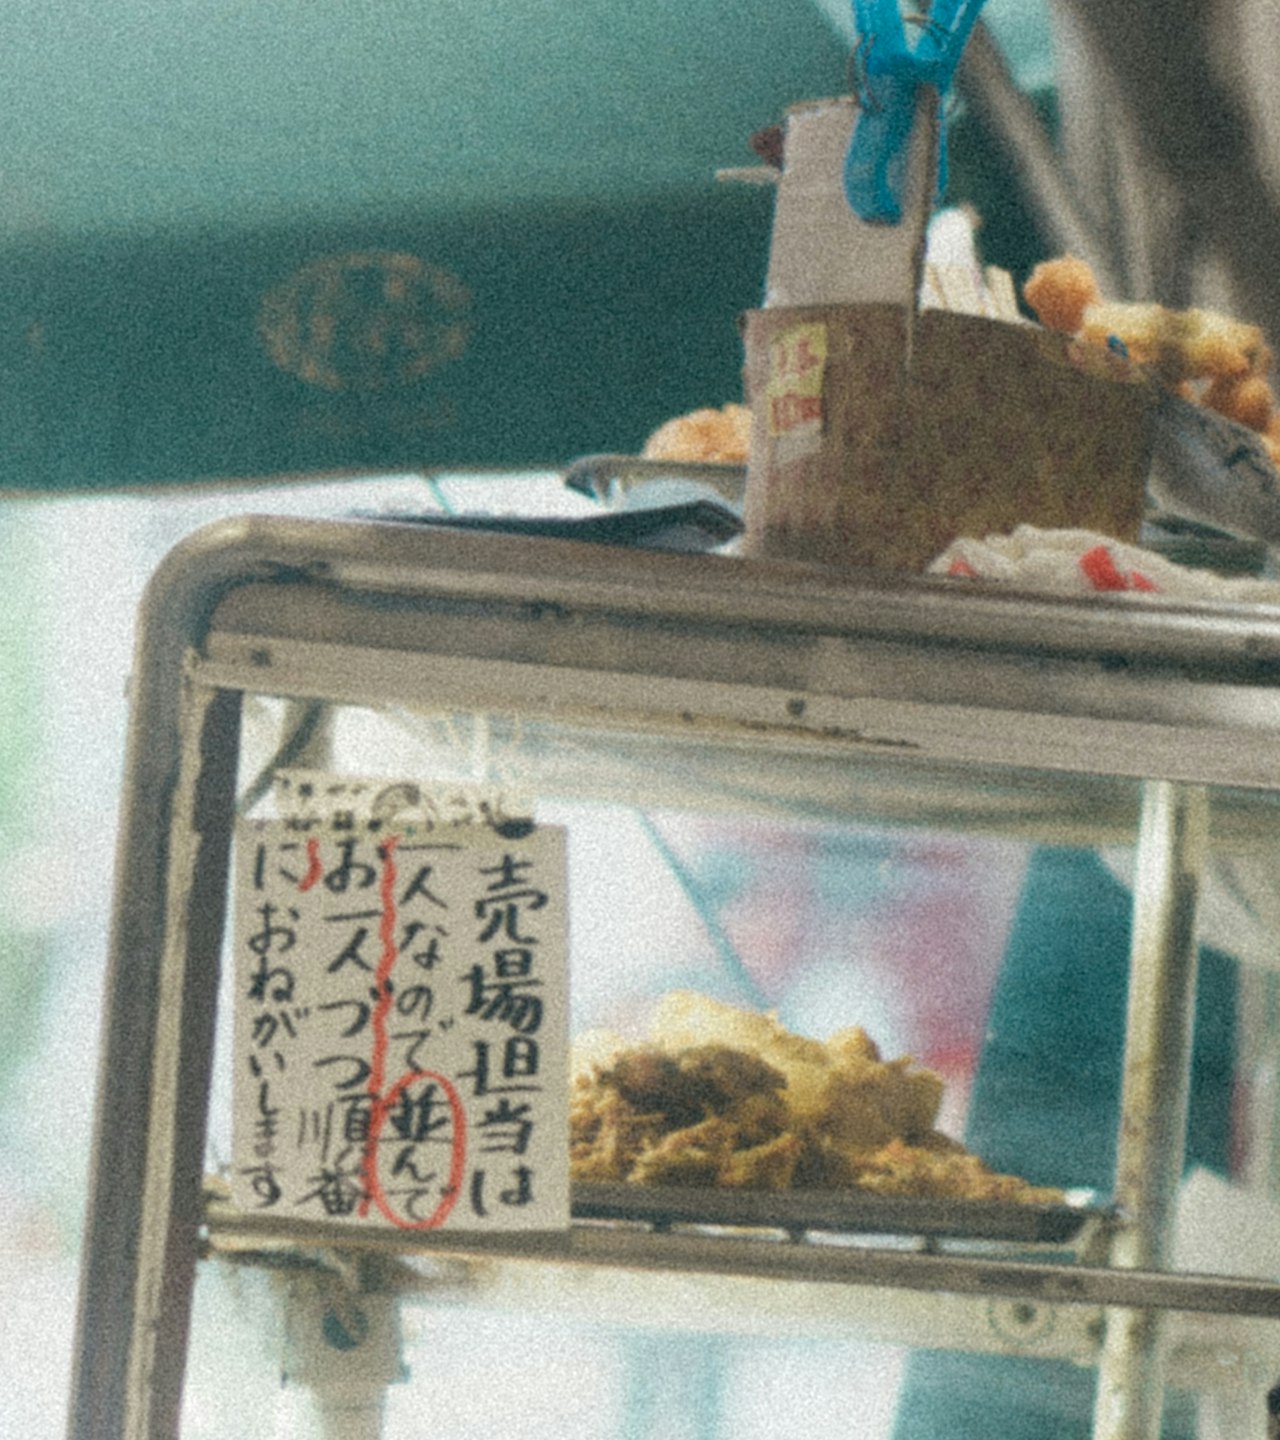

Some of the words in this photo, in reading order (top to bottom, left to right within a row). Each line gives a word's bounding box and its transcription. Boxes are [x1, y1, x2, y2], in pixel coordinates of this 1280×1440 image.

[457, 853, 549, 1216] 売場担当は
